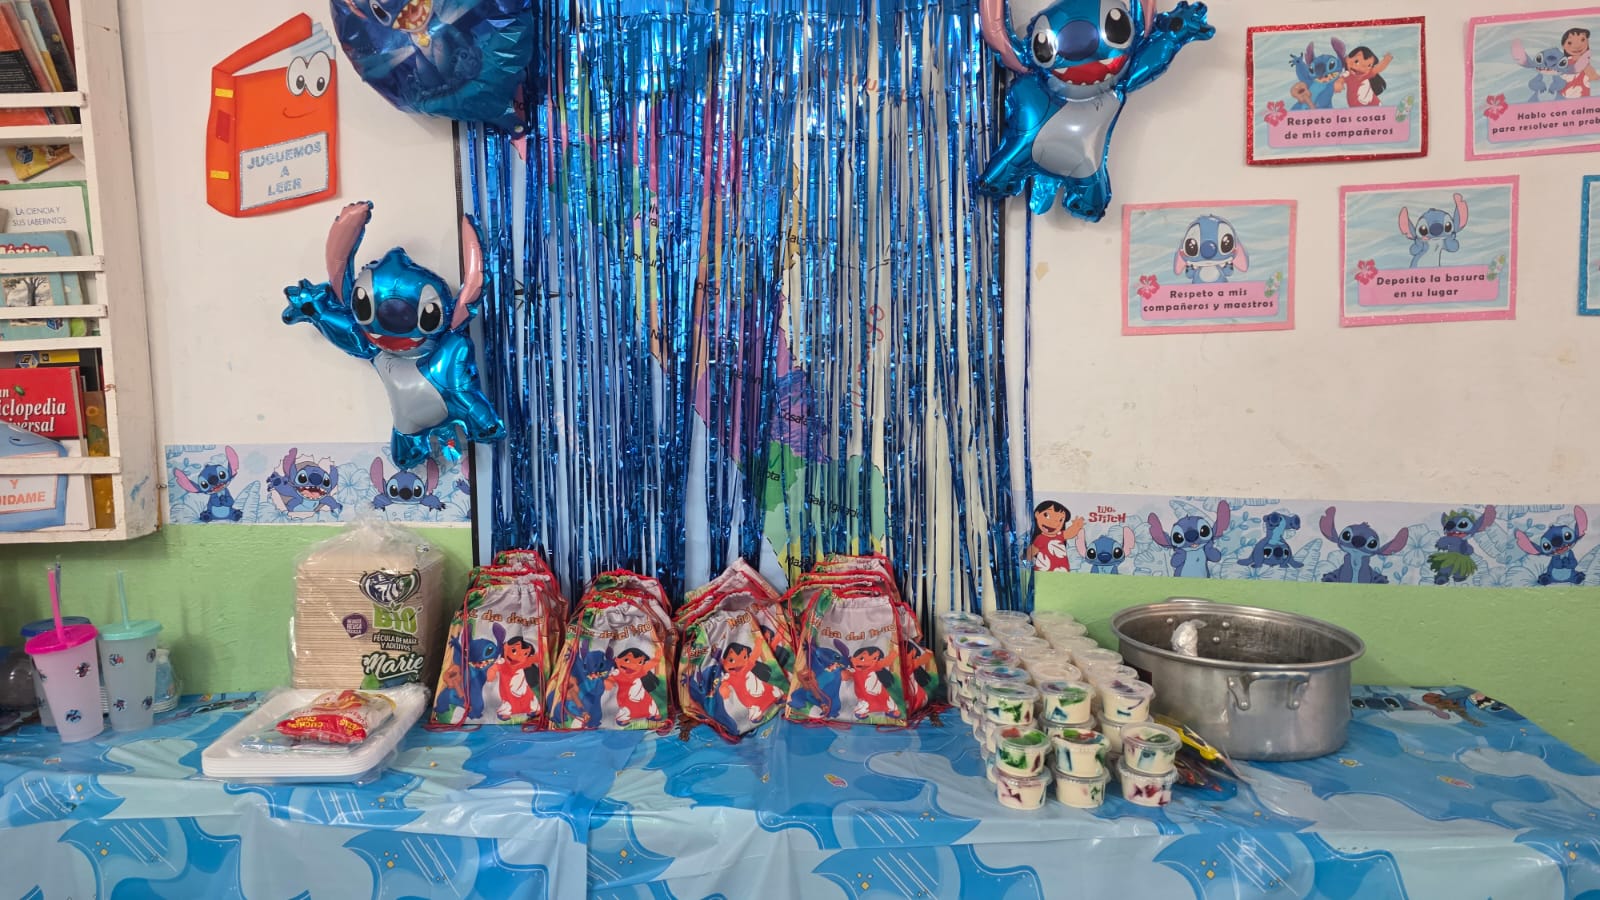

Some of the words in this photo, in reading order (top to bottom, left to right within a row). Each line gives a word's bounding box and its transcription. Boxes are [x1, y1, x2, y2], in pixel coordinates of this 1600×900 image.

[1287, 116, 1332, 127] Respeto
[1336, 115, 1352, 124] las
[1356, 113, 1386, 122] cosas
[1517, 112, 1546, 120] Hablo
[1550, 110, 1568, 118] con
[1284, 131, 1298, 140] de
[1302, 130, 1321, 139] mis
[1325, 128, 1393, 139] compañeros
[1492, 126, 1515, 135] para
[1519, 122, 1559, 131] resolver
[247, 141, 321, 170] JUGUEMOS
[280, 166, 290, 177] A
[267, 178, 302, 196] LEER
[26, 207, 54, 215] CIENCIA
[12, 219, 26, 227] SUS
[27, 217, 67, 226] LABERINTOS
[1376, 276, 1426, 286] Deposito
[1430, 275, 1441, 283] la
[1445, 273, 1485, 282] basura
[1169, 290, 1214, 299] Respeto
[1228, 288, 1248, 297] mis
[1411, 290, 1423, 298] su
[1427, 288, 1459, 298] lugar
[1143, 301, 1209, 313] compañeros
[1213, 303, 1220, 311] y
[1223, 300, 1274, 309] maestros
[9, 479, 19, 489] Y
[0, 491, 46, 505] IDAME
[373, 633, 395, 642] FÉCULA
[362, 653, 424, 680] Marie
